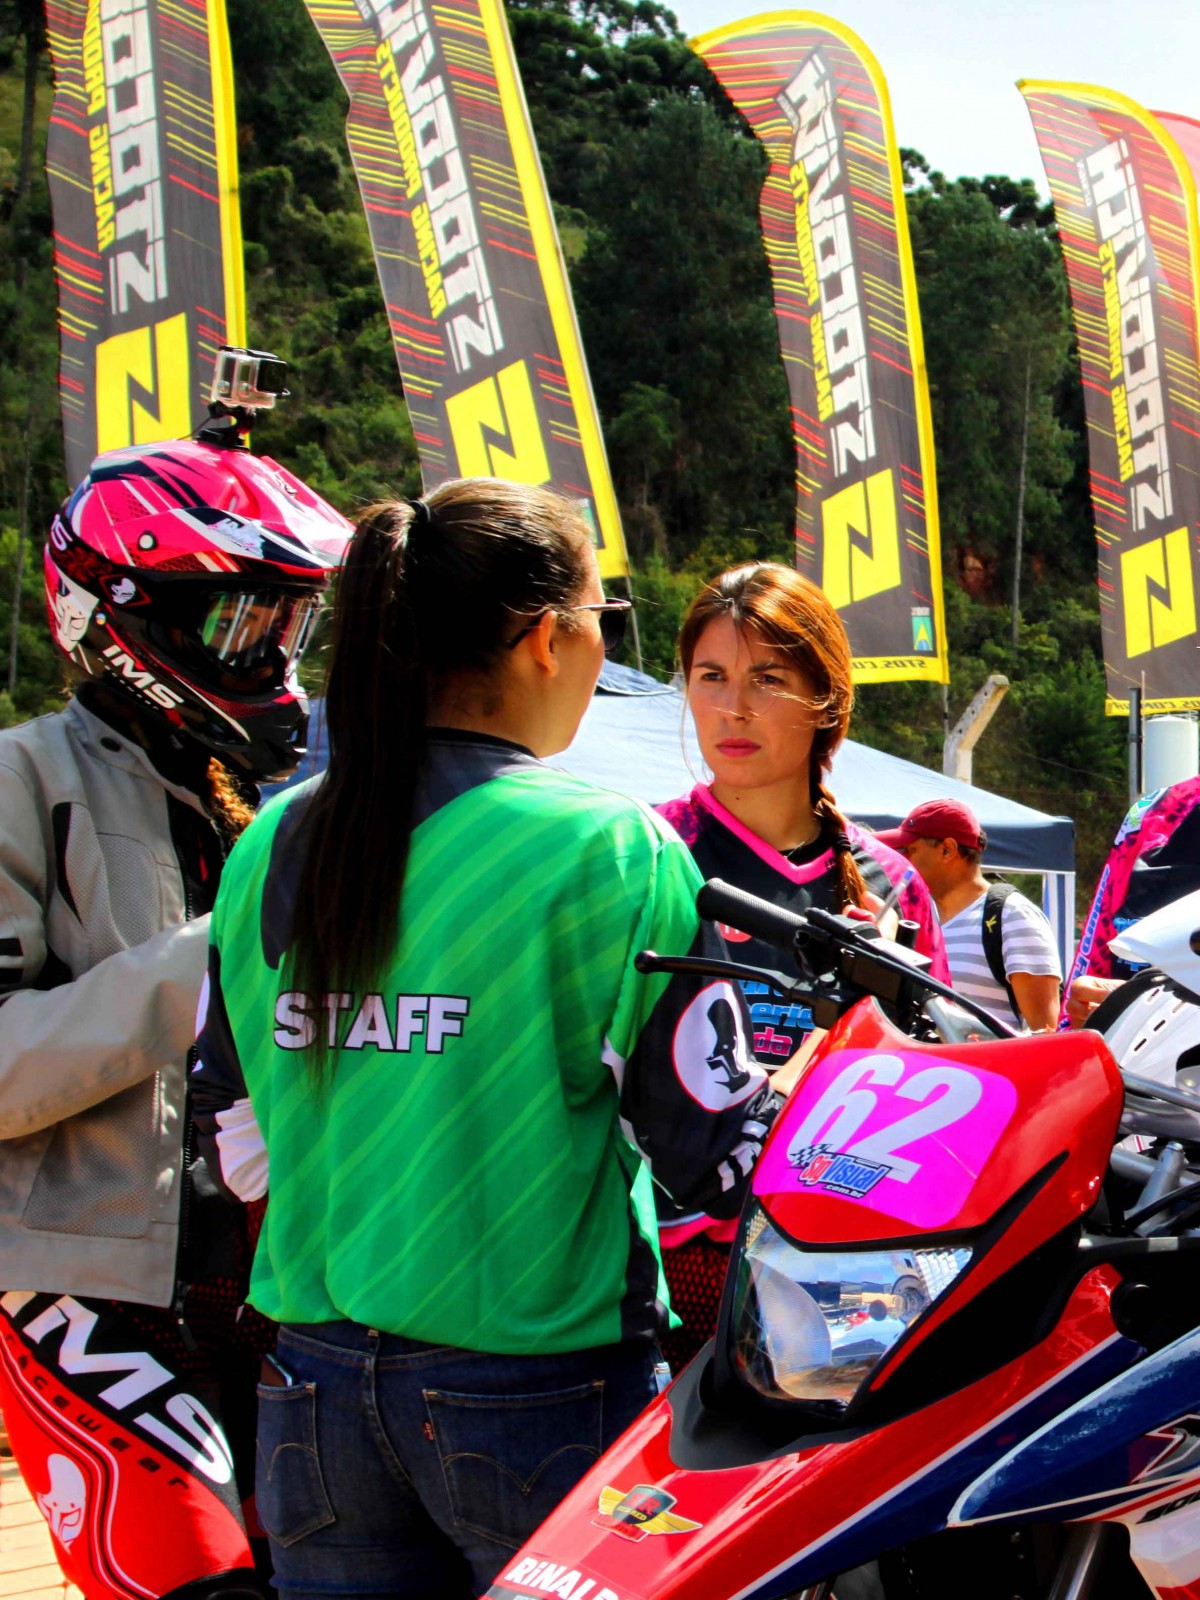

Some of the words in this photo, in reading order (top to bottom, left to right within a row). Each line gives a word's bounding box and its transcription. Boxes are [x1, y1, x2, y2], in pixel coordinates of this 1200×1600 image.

[102, 644, 185, 709] IMS
[271, 991, 471, 1054] STAFF
[786, 1053, 983, 1185] 62
[504, 1556, 618, 1600] RiNAL
